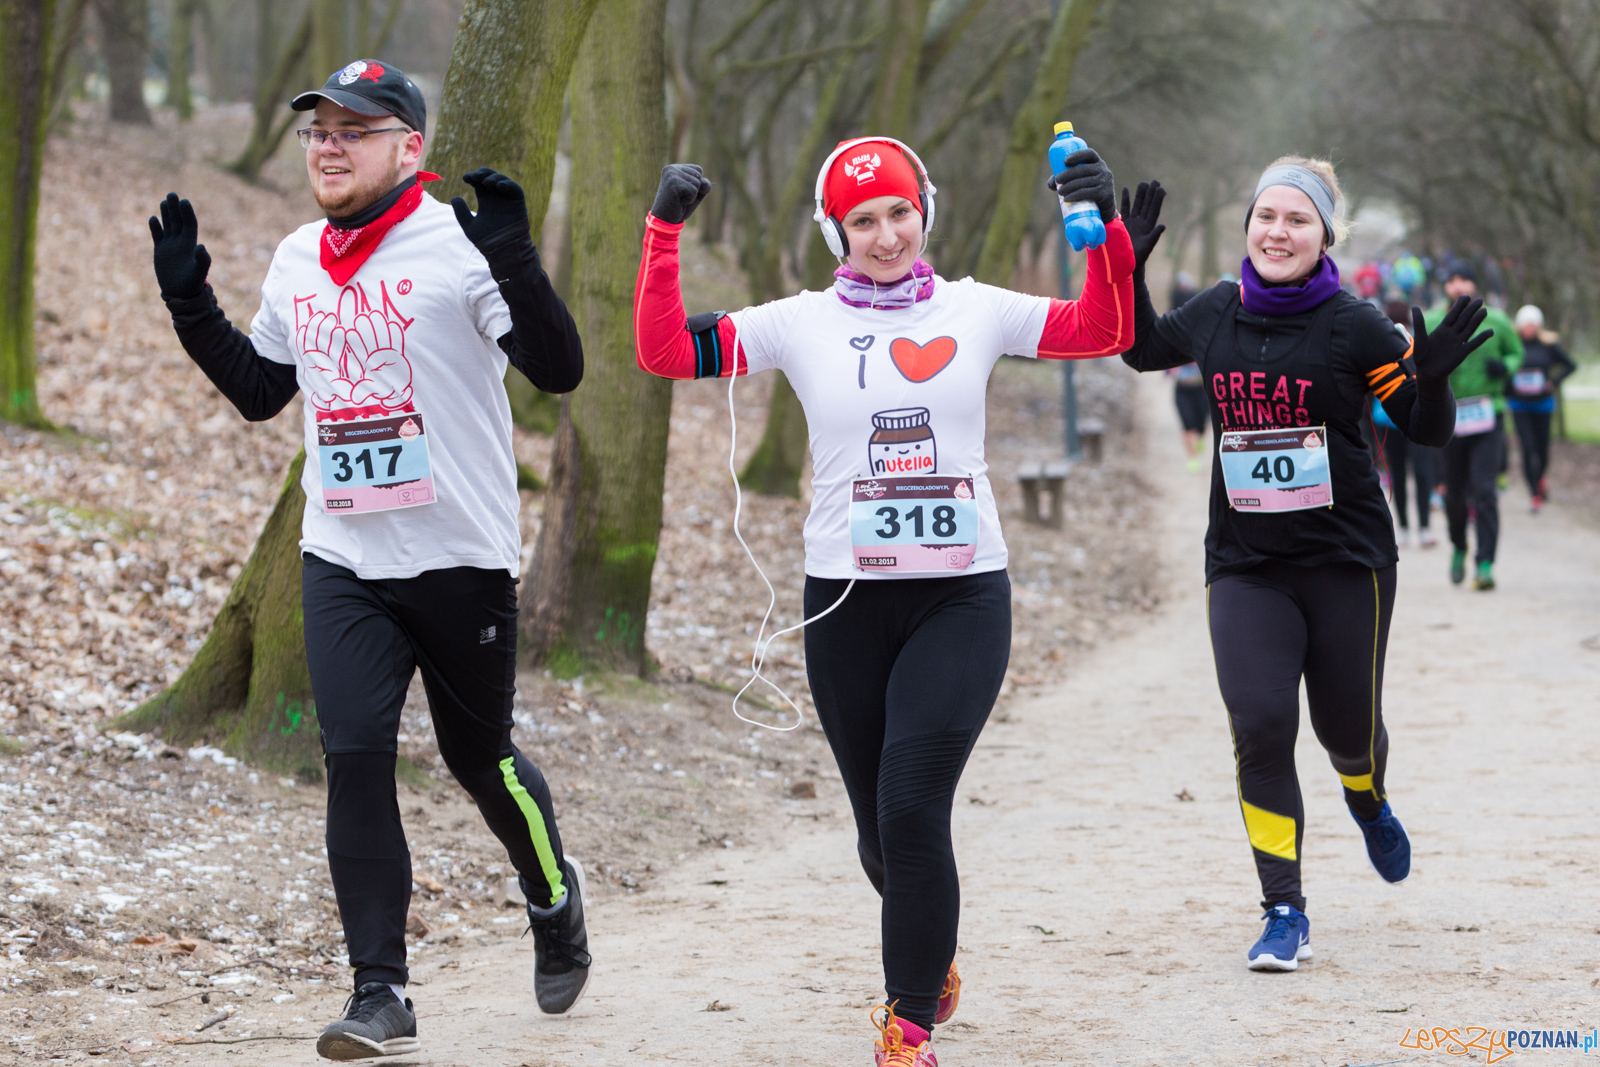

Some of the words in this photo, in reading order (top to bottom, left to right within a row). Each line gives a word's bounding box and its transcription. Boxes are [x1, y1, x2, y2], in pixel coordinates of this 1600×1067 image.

[1212, 371, 1313, 406] GREAT
[1217, 400, 1311, 427] THINGS
[331, 445, 403, 483] 317
[874, 455, 933, 473] nutella
[1251, 455, 1295, 483] 40
[875, 505, 957, 539] 318
